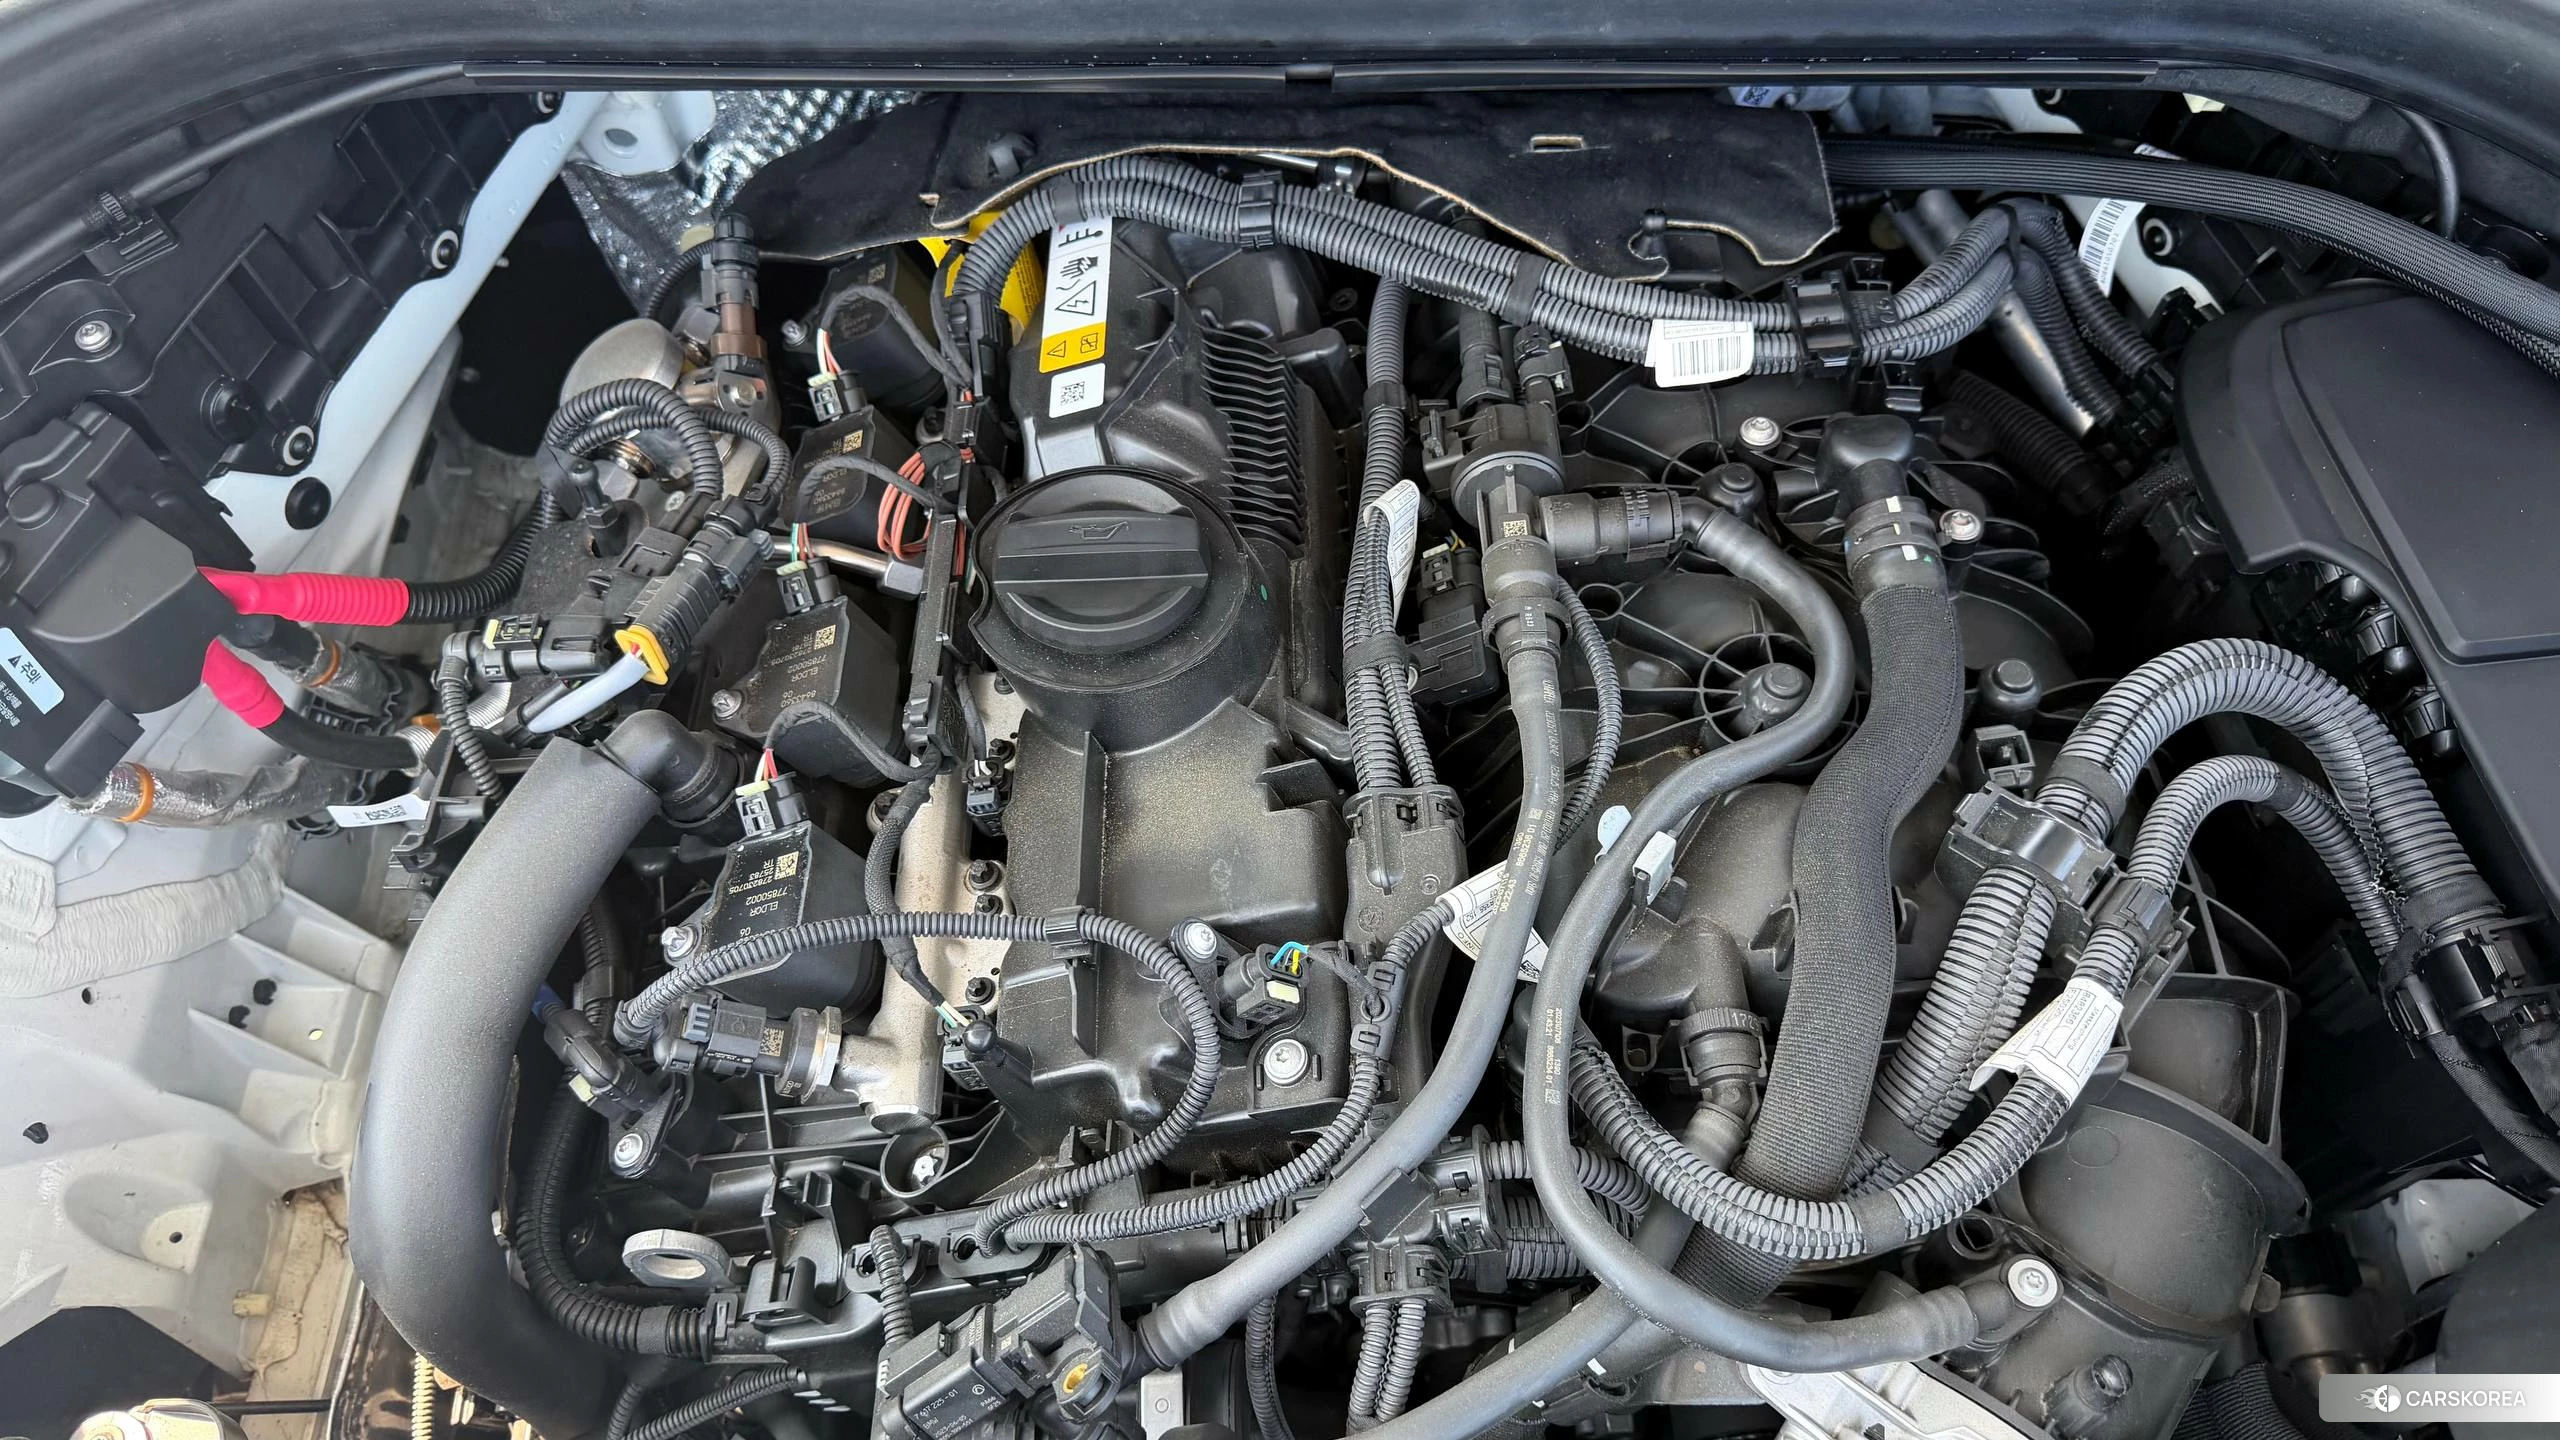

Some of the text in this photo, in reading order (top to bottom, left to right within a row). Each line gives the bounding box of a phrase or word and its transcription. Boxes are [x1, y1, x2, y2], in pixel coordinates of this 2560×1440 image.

[802, 632, 812, 642] TR
[786, 653, 827, 673] 77850002
[20, 661, 42, 684] 주의!
[790, 665, 819, 682] ELDOR
[780, 688, 817, 708] 8643360
[1526, 822, 1537, 834] 01
[763, 857, 774, 868] TR
[748, 866, 774, 881] 25783
[728, 874, 773, 894] 278230705
[745, 886, 788, 905] 77850002
[749, 900, 778, 917] ELDOR
[739, 925, 751, 937] 06
[1457, 931, 1477, 951] INFO
[1545, 1074, 1552, 1083] 01
